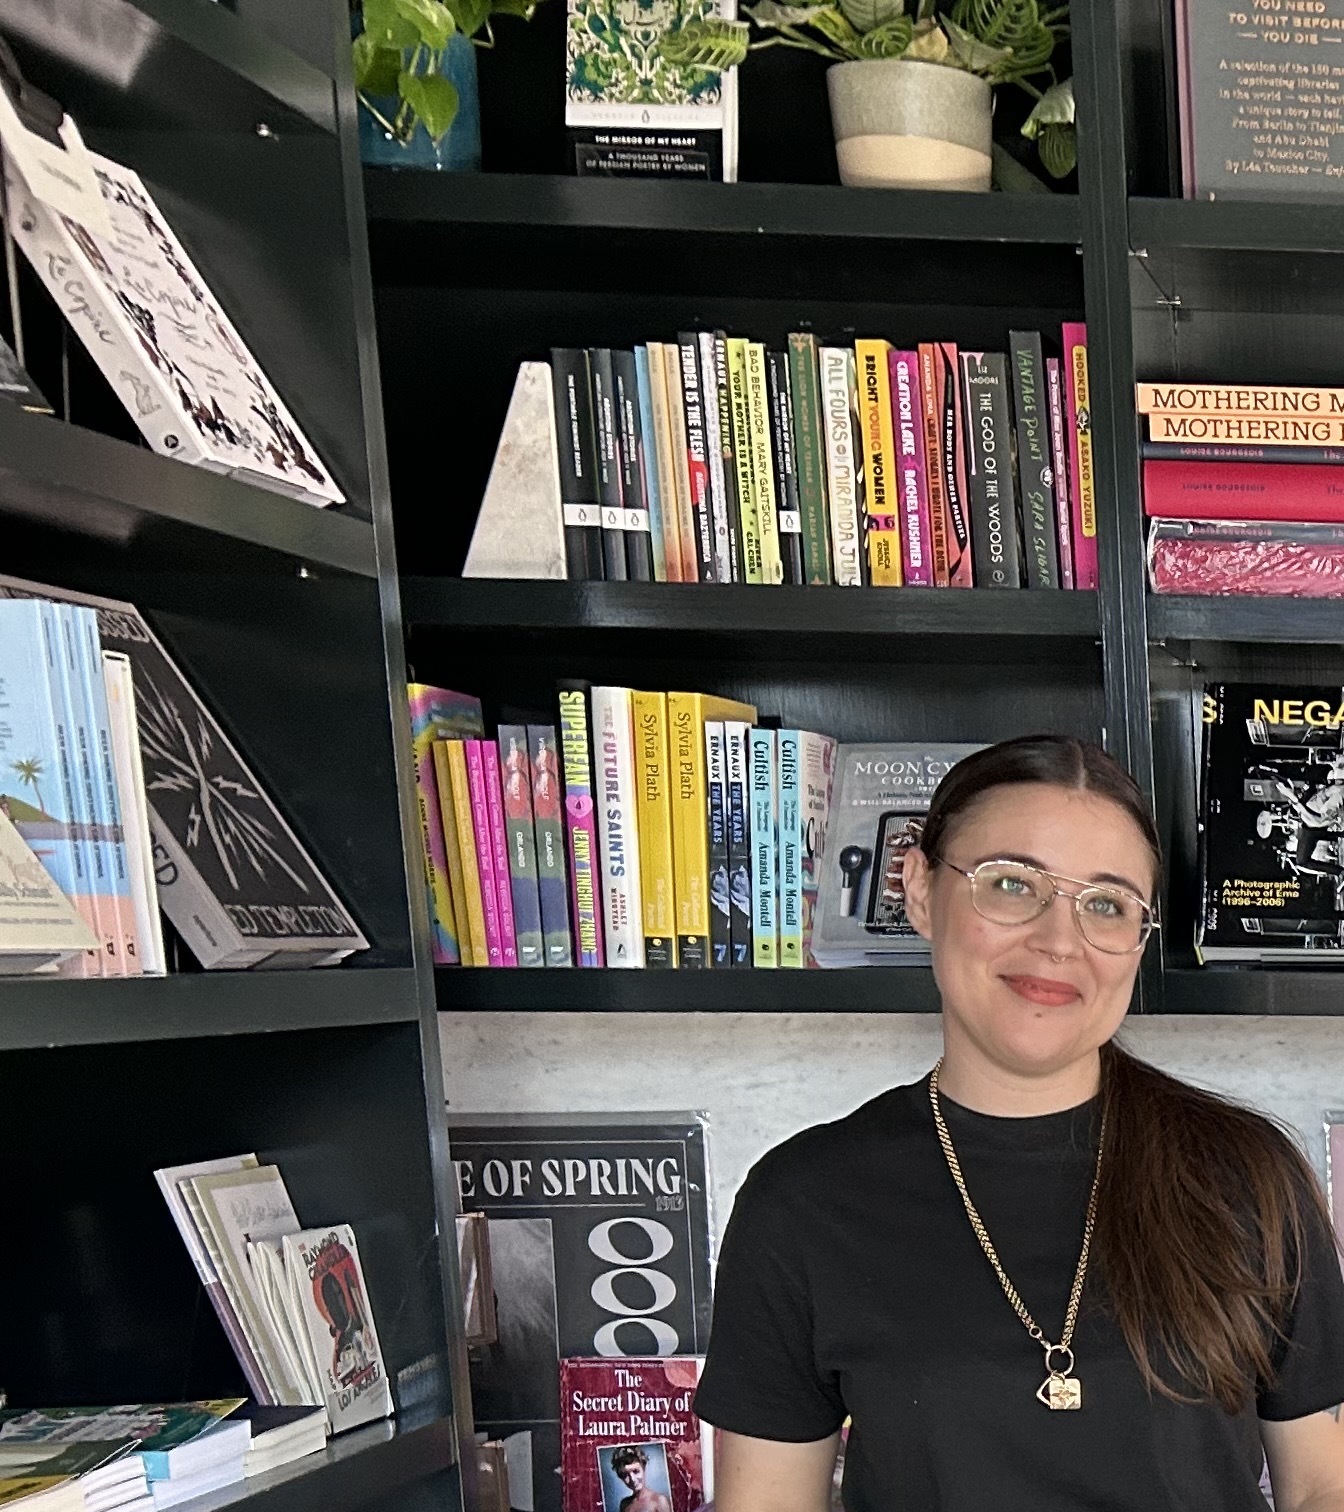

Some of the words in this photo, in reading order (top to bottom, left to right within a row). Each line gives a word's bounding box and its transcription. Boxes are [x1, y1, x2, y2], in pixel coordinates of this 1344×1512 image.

[1229, 13, 1247, 25] TO
[1252, 16, 1288, 27] VISIT
[1295, 32, 1318, 44] DIE
[865, 355, 878, 406] BRIGHT
[980, 393, 991, 413] THE
[1152, 389, 1321, 412] MOTHERING
[869, 407, 881, 449] YOUNG
[981, 416, 994, 452] GOD
[1075, 351, 1086, 403] HOOKED
[1082, 487, 1093, 530] YUZUKI
[872, 452, 886, 506] WOMEN
[983, 457, 997, 475] OF
[987, 480, 999, 499] THE
[988, 504, 1003, 563] WOODS
[558, 690, 590, 787] SUPERFAN
[642, 713, 658, 758] Sylvia
[646, 763, 658, 802] Plath
[753, 740, 770, 791] Cultish
[758, 841, 770, 890] Amanda
[760, 890, 772, 929] Montell
[483, 1160, 532, 1198] OF
[540, 1157, 682, 1197] SPRING
[615, 1370, 643, 1388] The
[573, 1392, 623, 1412] Secret
[628, 1391, 670, 1417] Diary
[673, 1390, 690, 1411] of
[578, 1415, 626, 1437] Laura
[629, 1413, 688, 1437] Palmer
